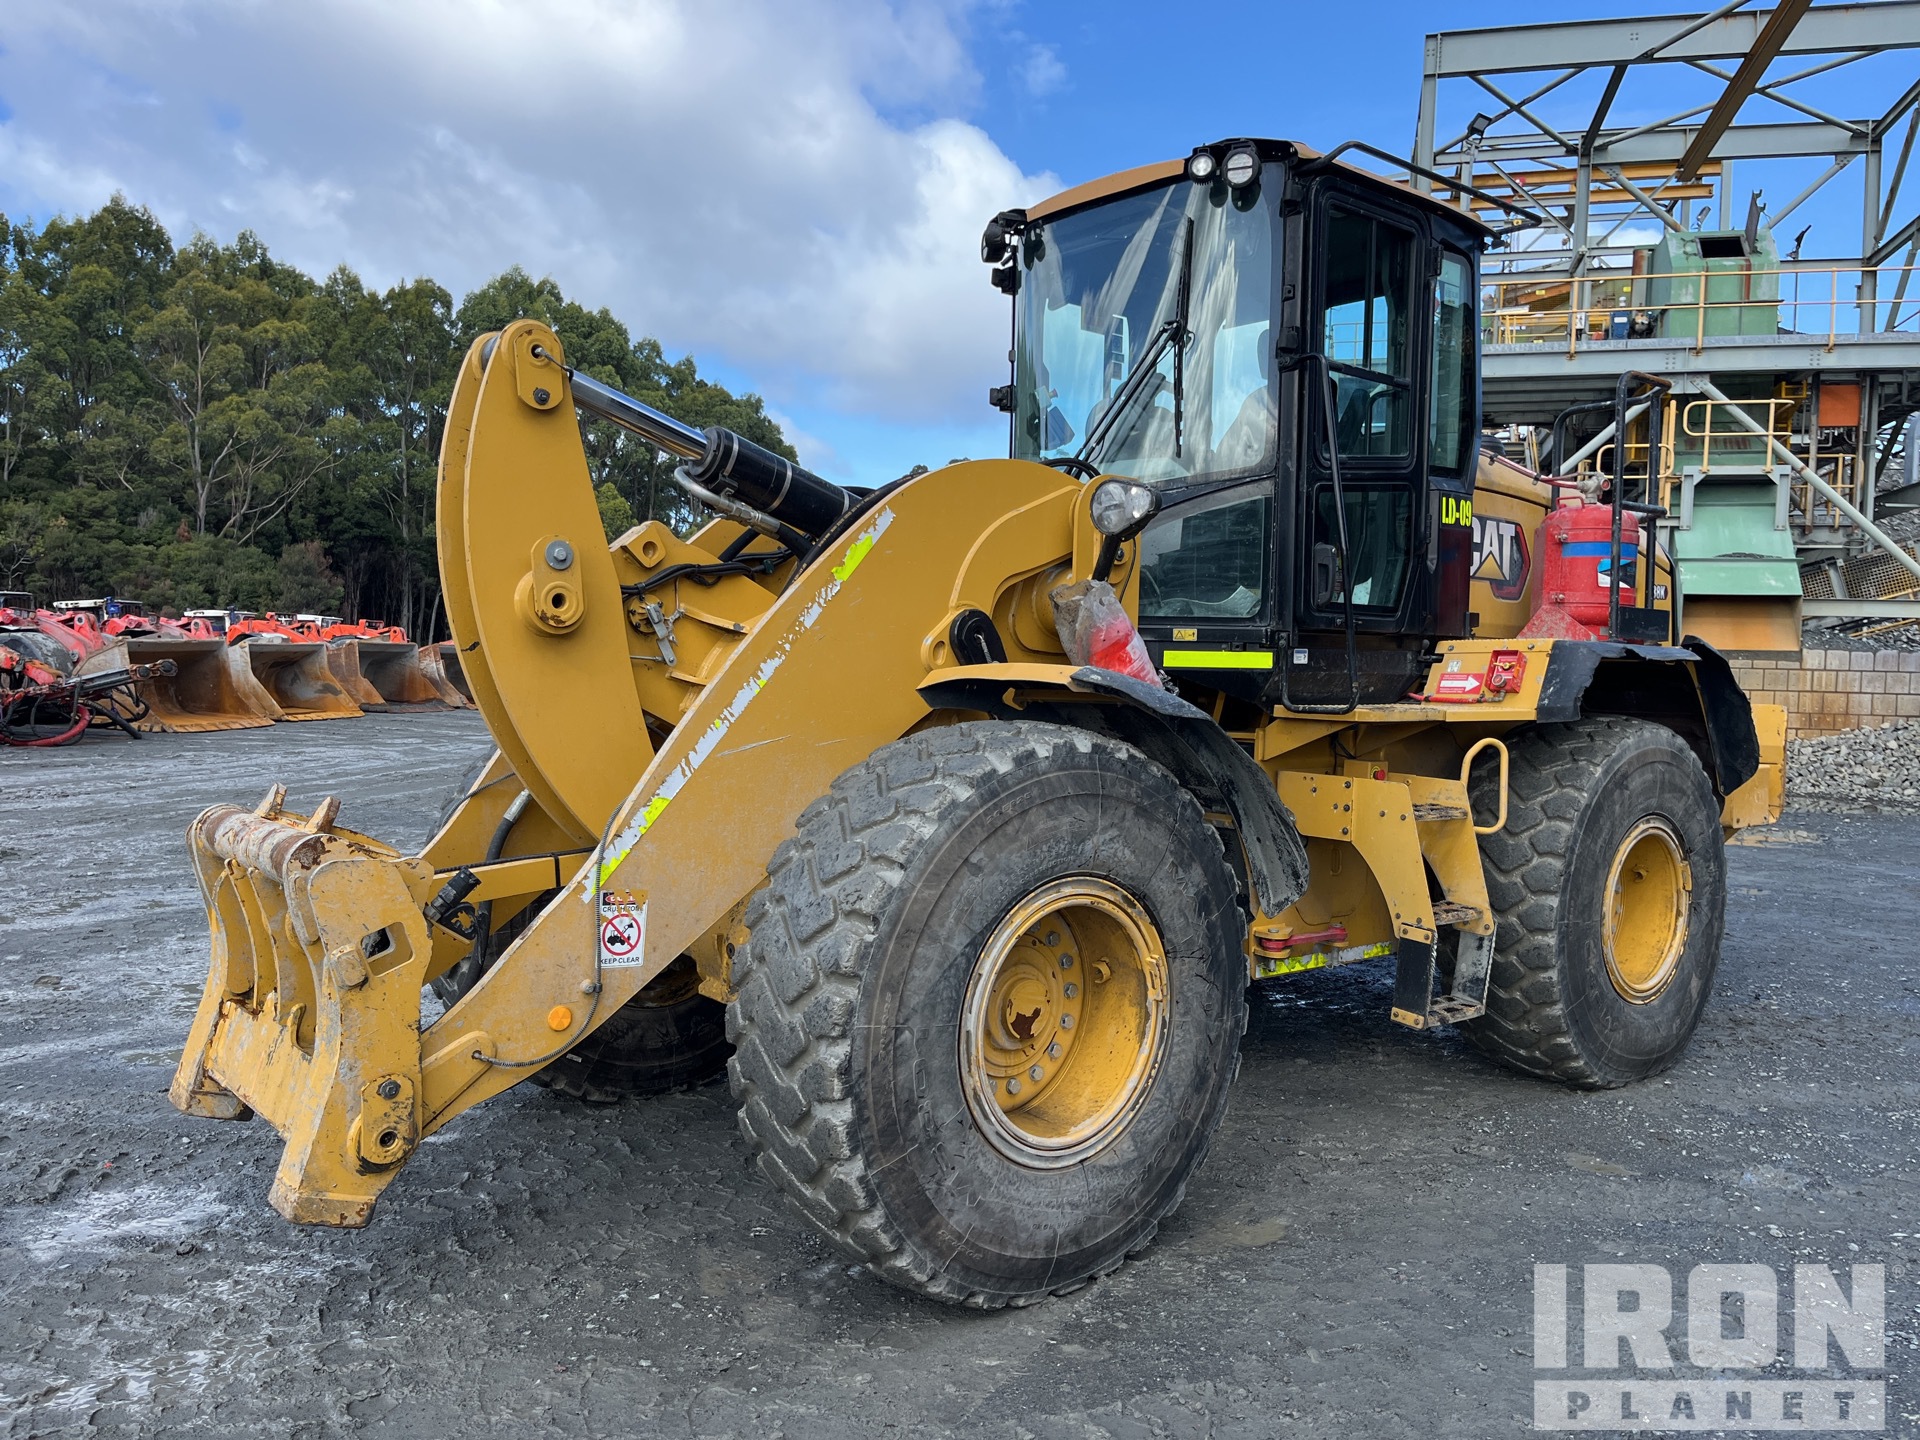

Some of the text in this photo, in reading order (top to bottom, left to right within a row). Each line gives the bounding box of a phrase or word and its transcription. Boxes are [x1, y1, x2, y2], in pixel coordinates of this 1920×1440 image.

[1442, 496, 1472, 527] LD-09
[1470, 516, 1515, 580] CAT
[603, 905, 626, 913] CRUH
[618, 956, 640, 964] CLEAR
